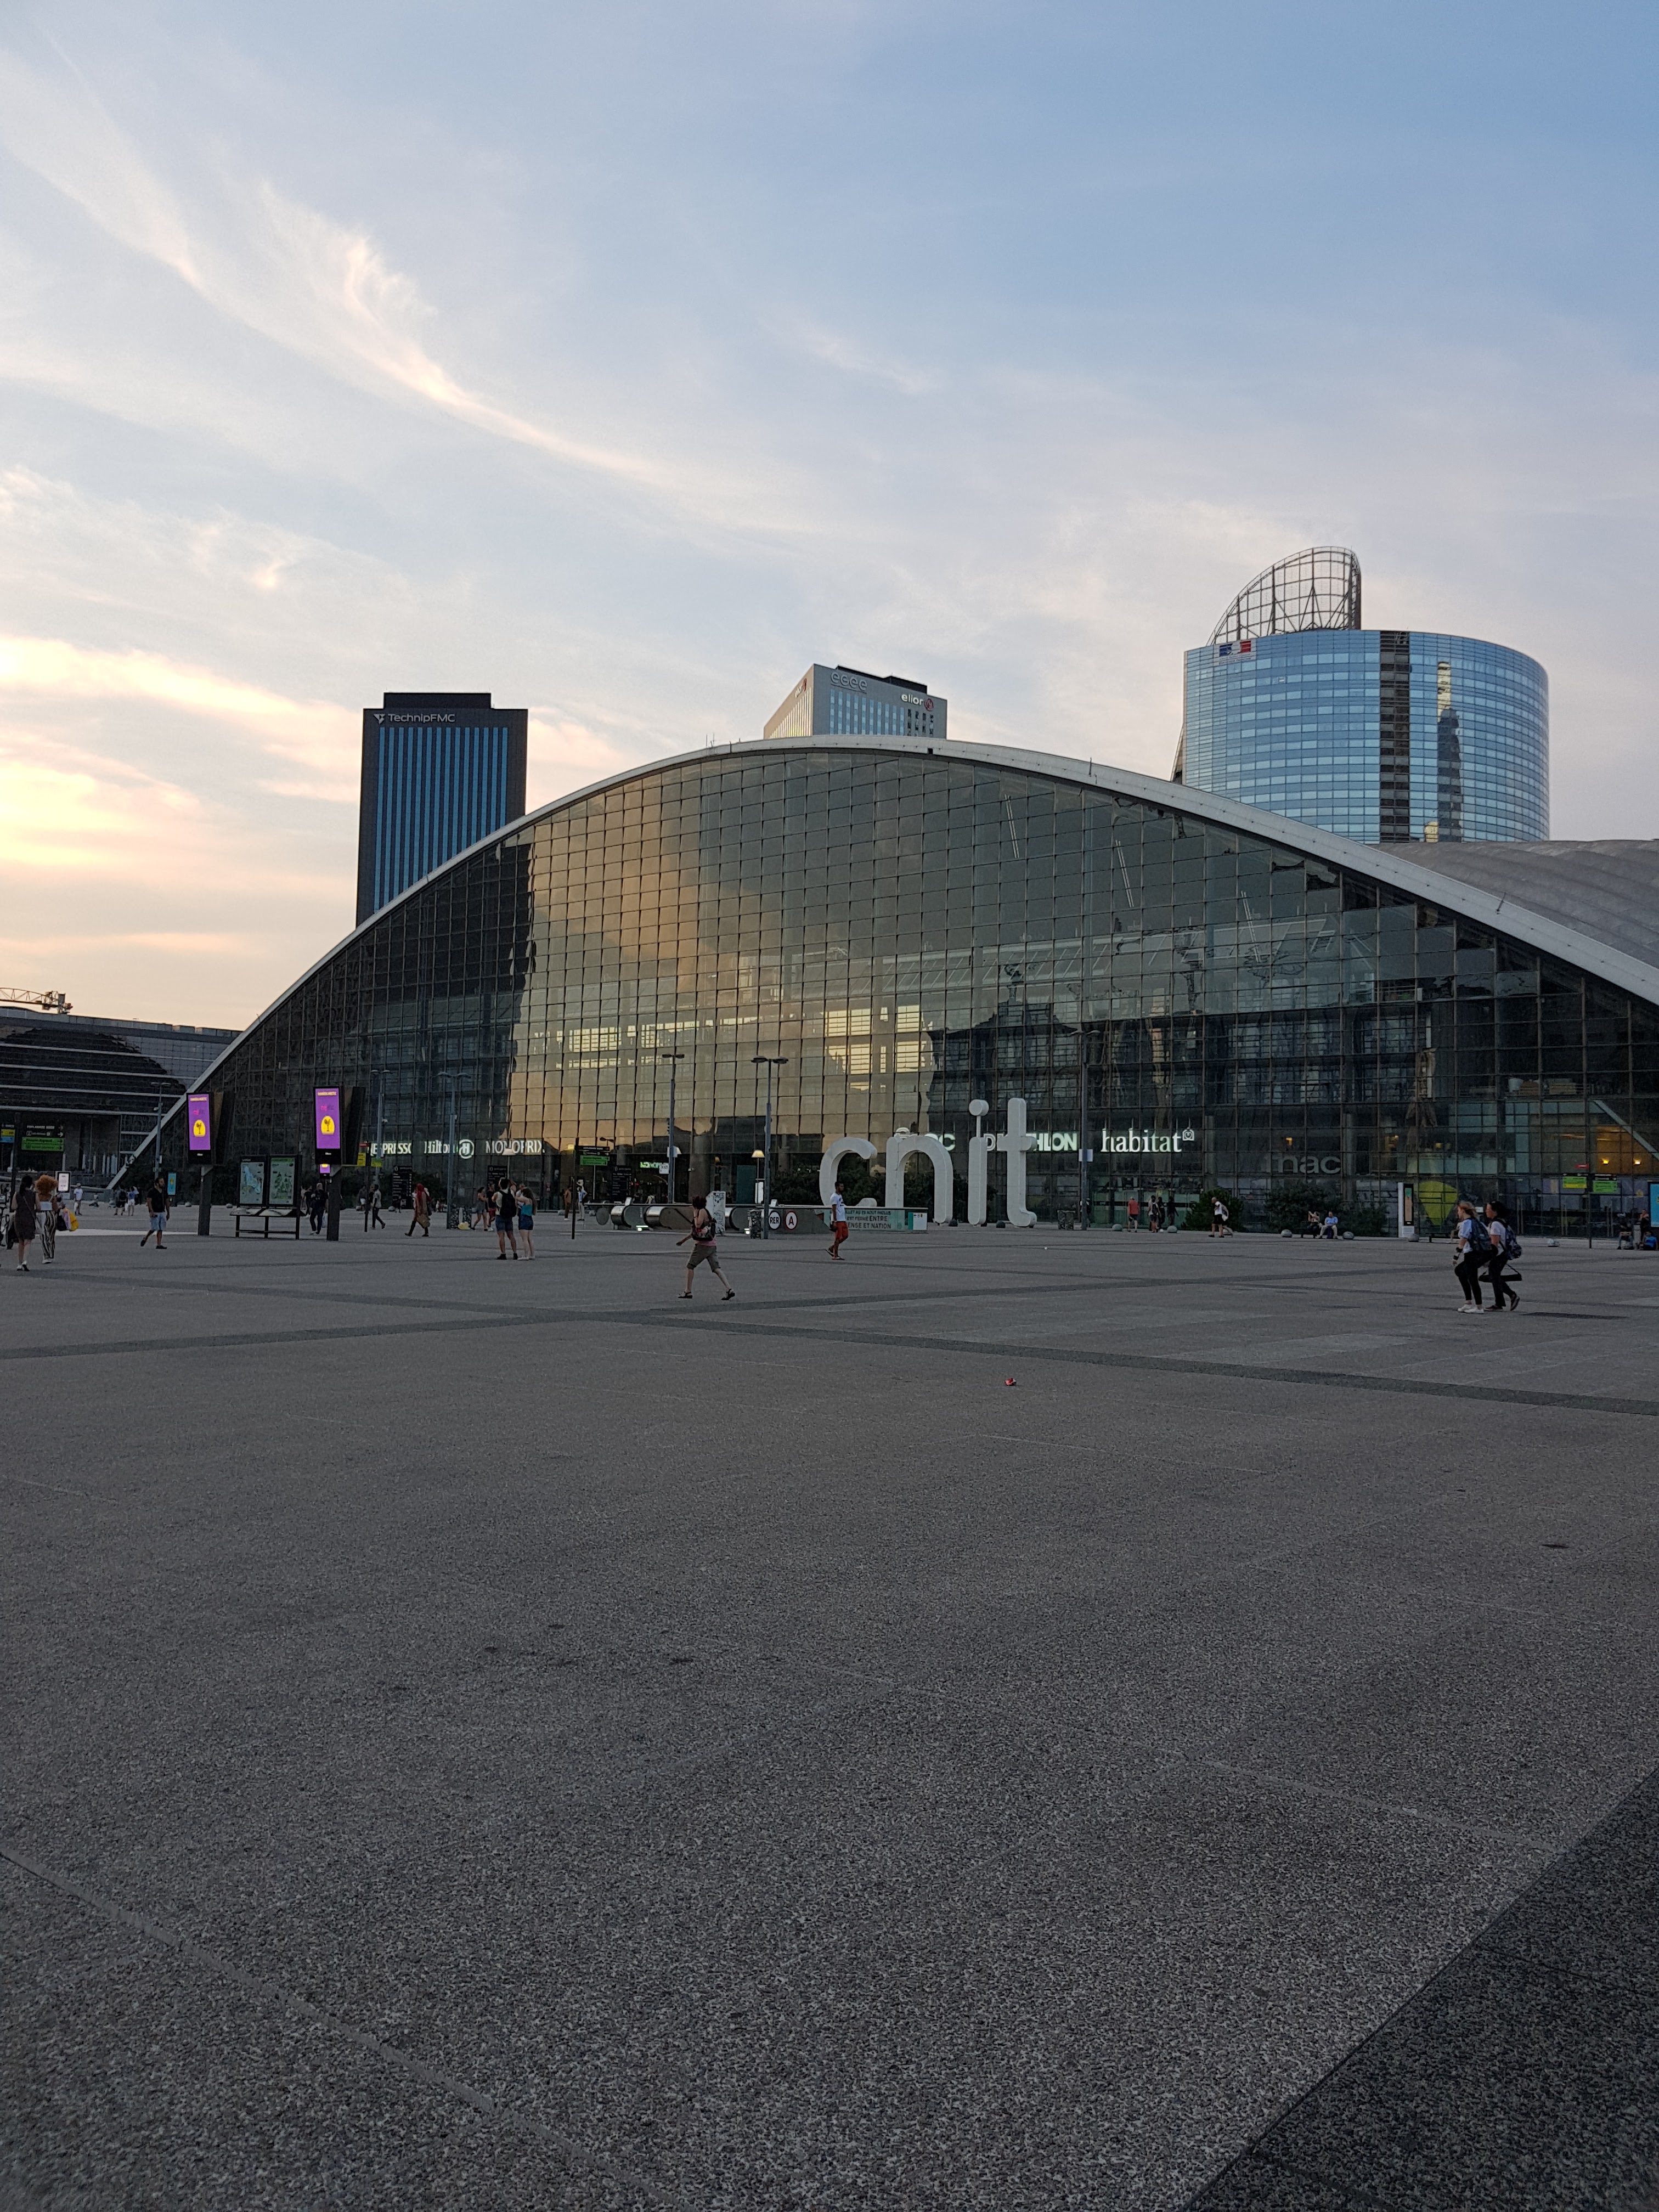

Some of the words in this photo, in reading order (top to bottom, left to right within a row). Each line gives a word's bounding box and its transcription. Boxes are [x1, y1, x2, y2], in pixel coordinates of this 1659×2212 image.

[901, 693, 924, 706] elior
[388, 713, 455, 723] TechnipFMC
[424, 1139, 455, 1154] Hilton
[486, 1140, 545, 1154] MONOPRIX
[984, 1133, 1078, 1152] DHLON
[1101, 1128, 1182, 1153] habitat
[367, 1142, 412, 1156] NEPRESS
[819, 1098, 1037, 1228] cnit
[788, 1216, 794, 1226] A
